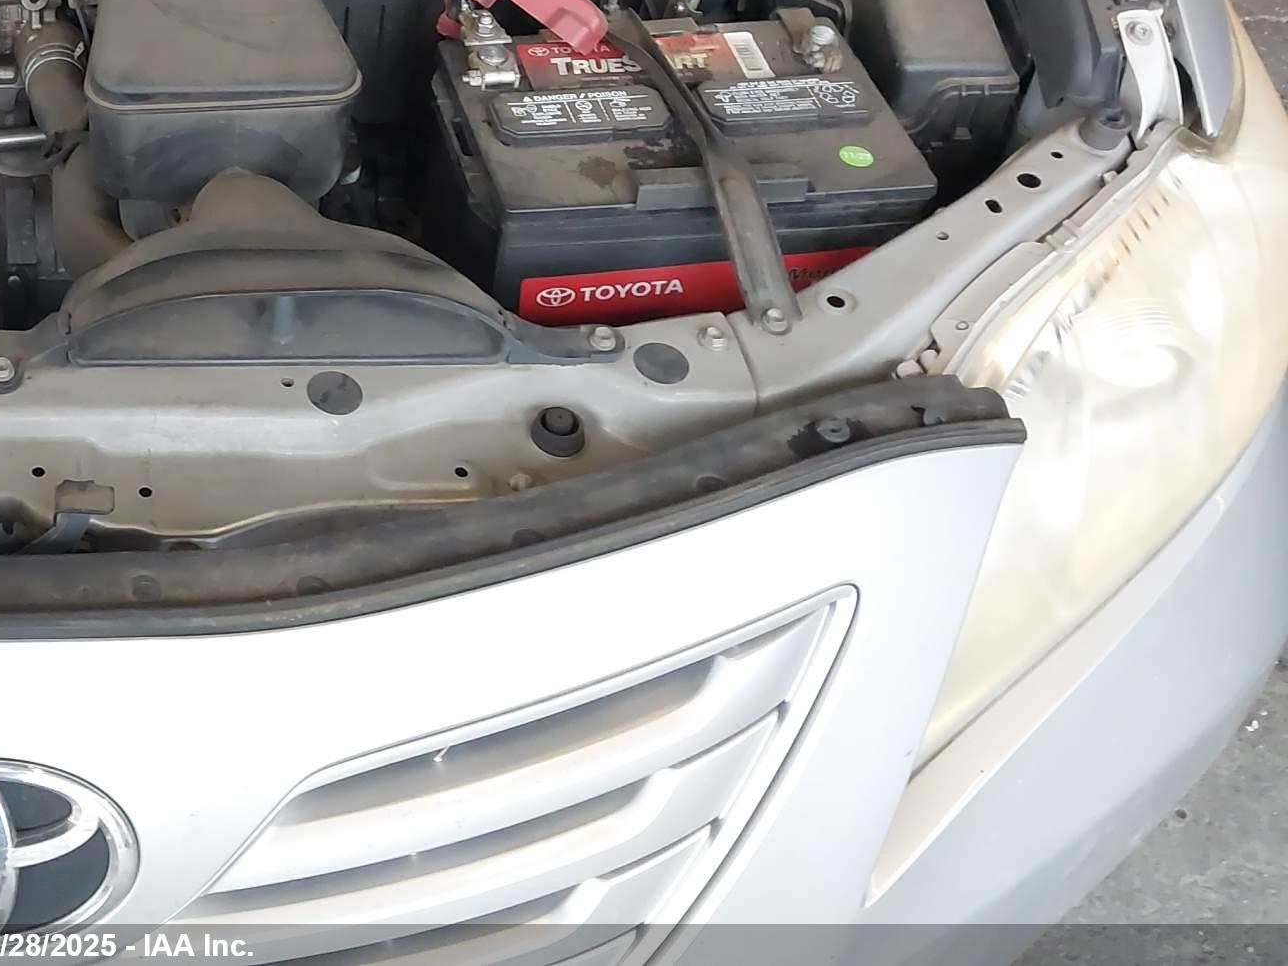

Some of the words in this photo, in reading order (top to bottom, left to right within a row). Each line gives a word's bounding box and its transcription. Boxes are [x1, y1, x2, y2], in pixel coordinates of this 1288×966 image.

[534, 93, 578, 102] DANGER
[587, 90, 628, 99] POISON
[580, 279, 684, 302] TOYOTA
